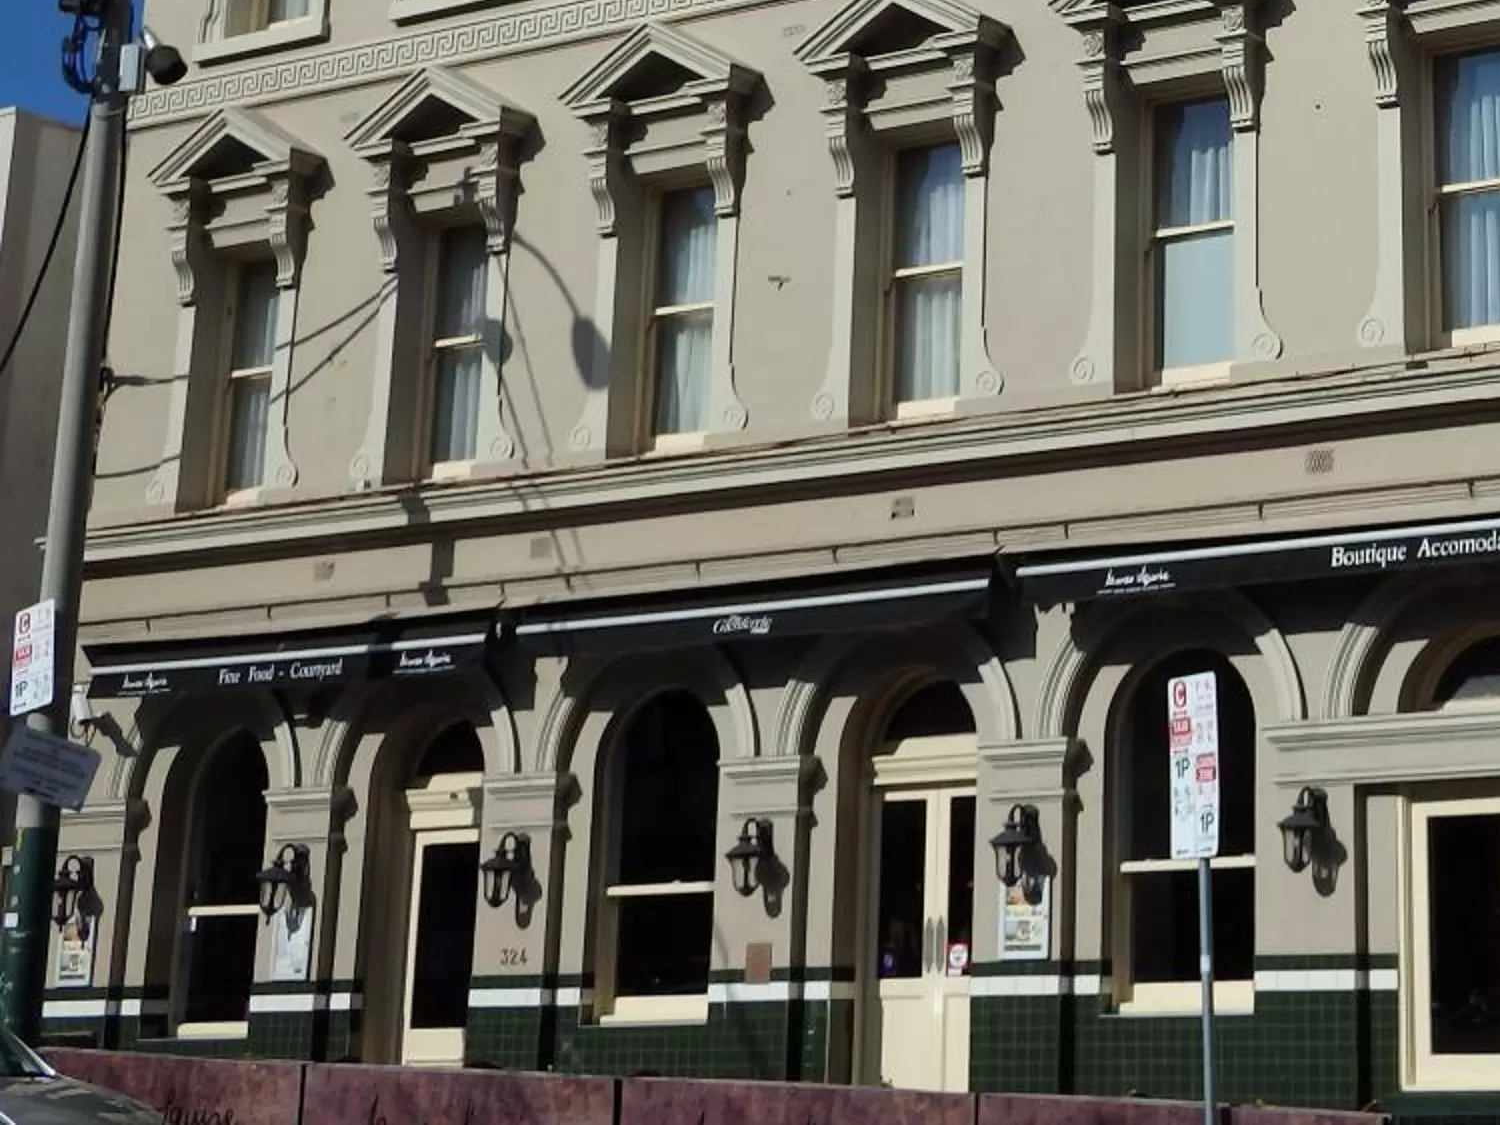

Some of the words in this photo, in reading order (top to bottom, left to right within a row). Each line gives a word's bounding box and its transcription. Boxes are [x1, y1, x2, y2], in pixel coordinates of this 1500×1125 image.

[1330, 542, 1408, 569] Boutique
[247, 664, 275, 683] Food
[1175, 758, 1190, 779] 1P
[1200, 811, 1215, 834] 1P
[500, 947, 528, 966] 324
